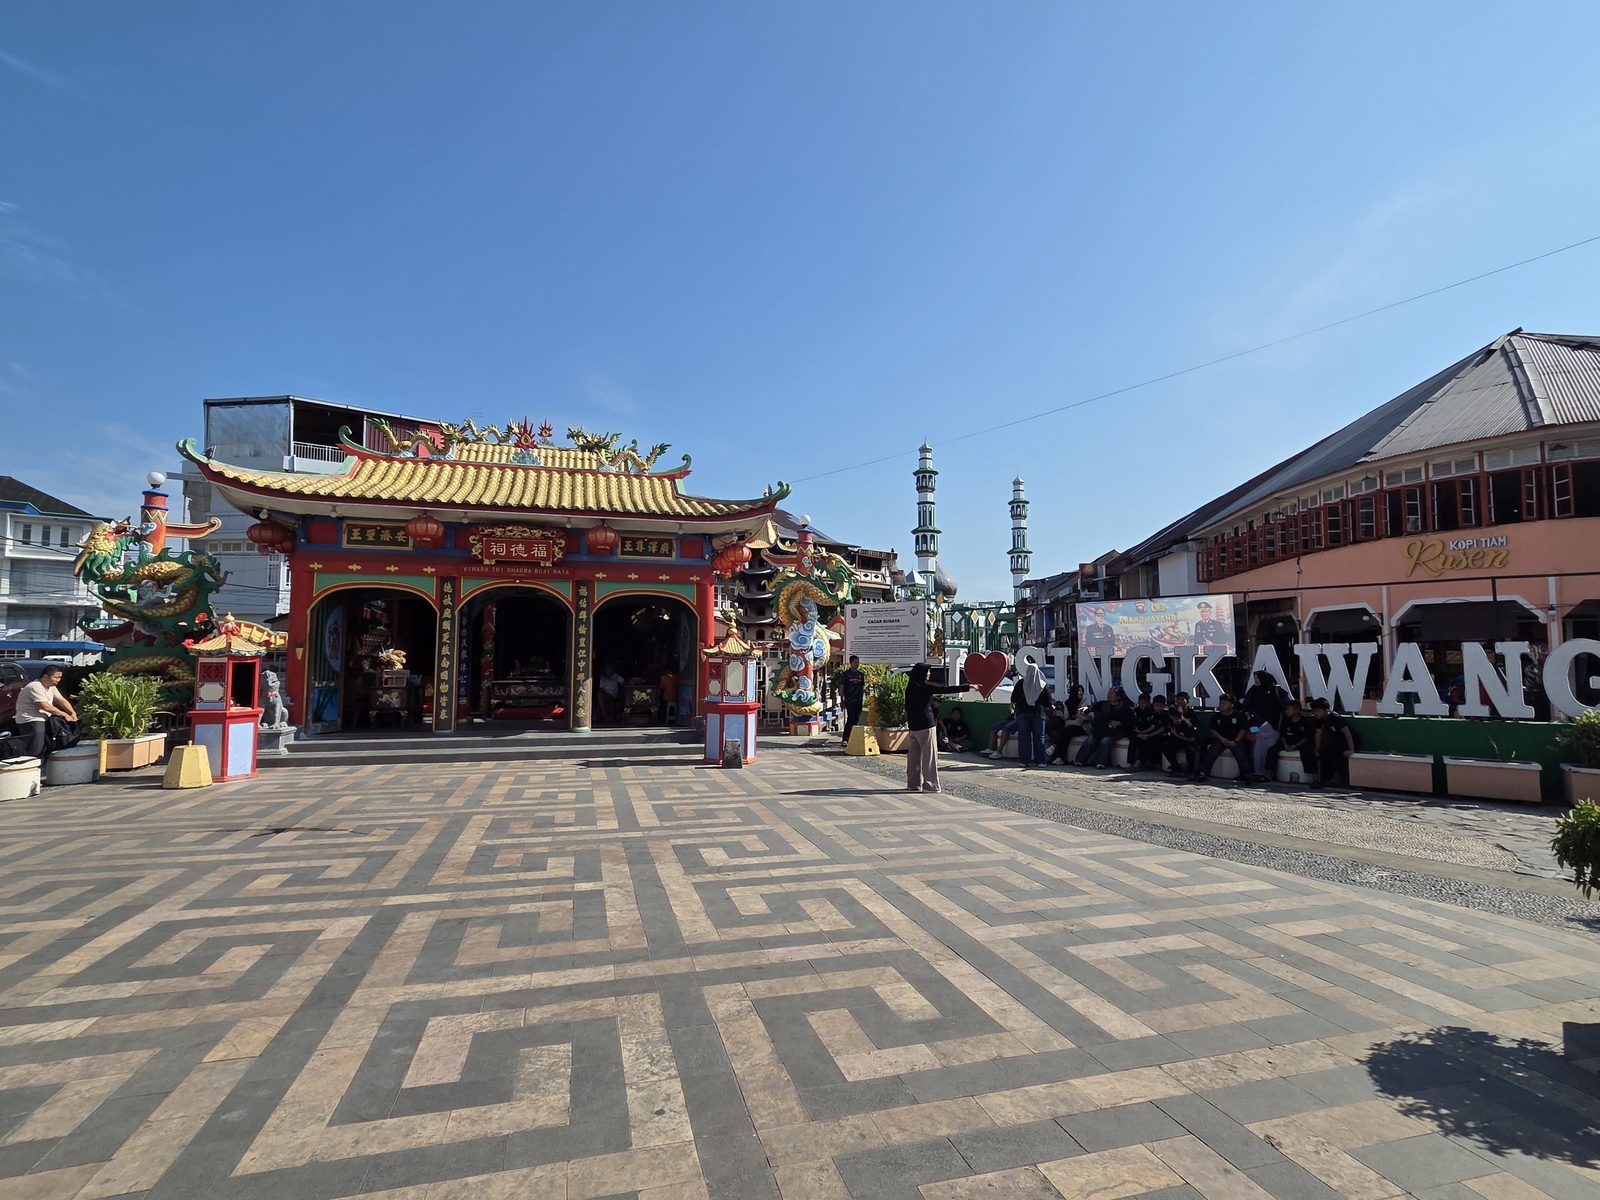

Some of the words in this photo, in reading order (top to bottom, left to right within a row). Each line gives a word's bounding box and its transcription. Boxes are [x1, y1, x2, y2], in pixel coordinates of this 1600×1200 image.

[489, 542, 547, 557] 福德祠
[1449, 538, 1477, 551] KOPI
[1480, 535, 1507, 548] TIAM
[1402, 538, 1511, 578] Rusen
[463, 565, 489, 573] VIHARA
[948, 649, 962, 700] I
